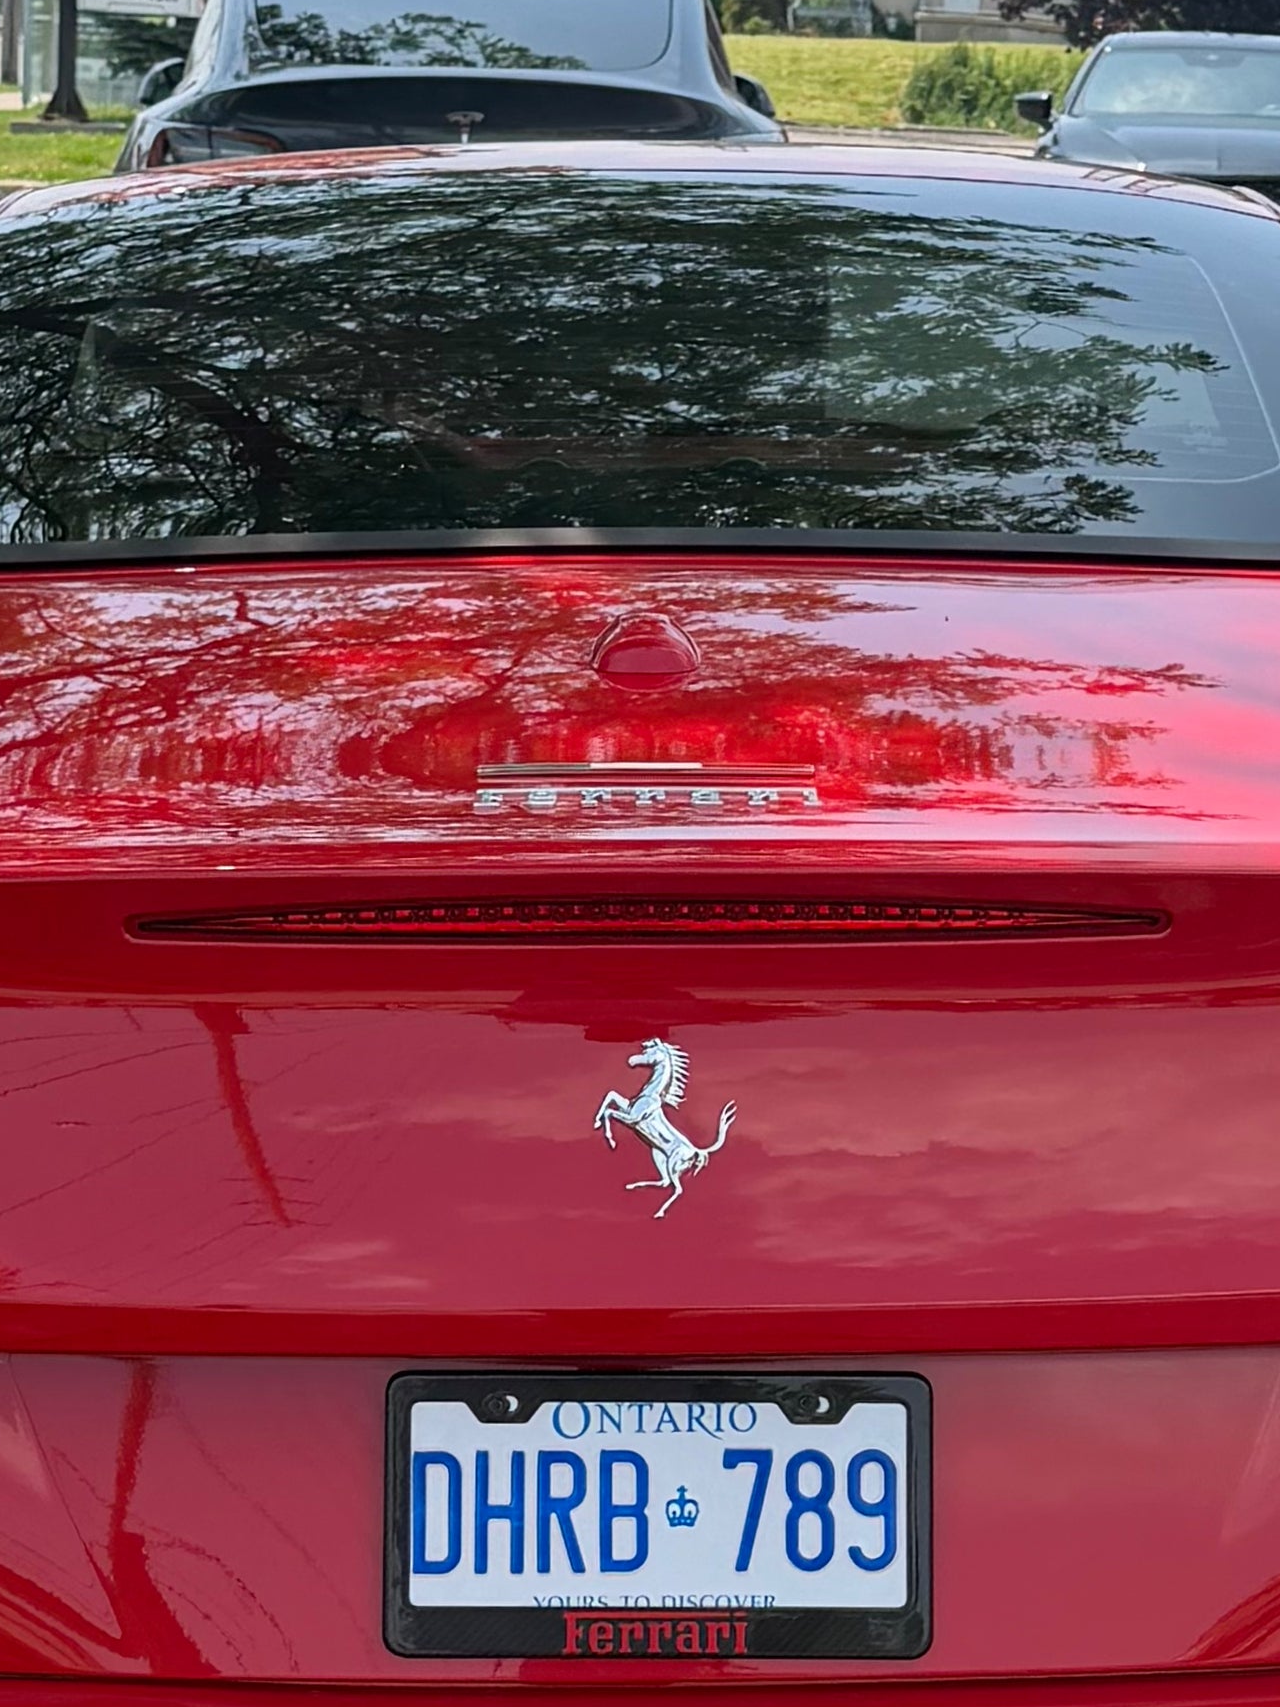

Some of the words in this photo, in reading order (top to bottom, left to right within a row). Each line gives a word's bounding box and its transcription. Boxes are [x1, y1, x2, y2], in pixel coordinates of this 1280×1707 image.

[553, 1400, 758, 1441] ONTARIO
[412, 1449, 650, 1575] DHRB
[722, 1448, 898, 1573] 789
[533, 1594, 608, 1608] YOURS
[620, 1594, 651, 1608] TO
[661, 1594, 776, 1608] DISCOVER
[562, 1611, 748, 1654] Ferrari
